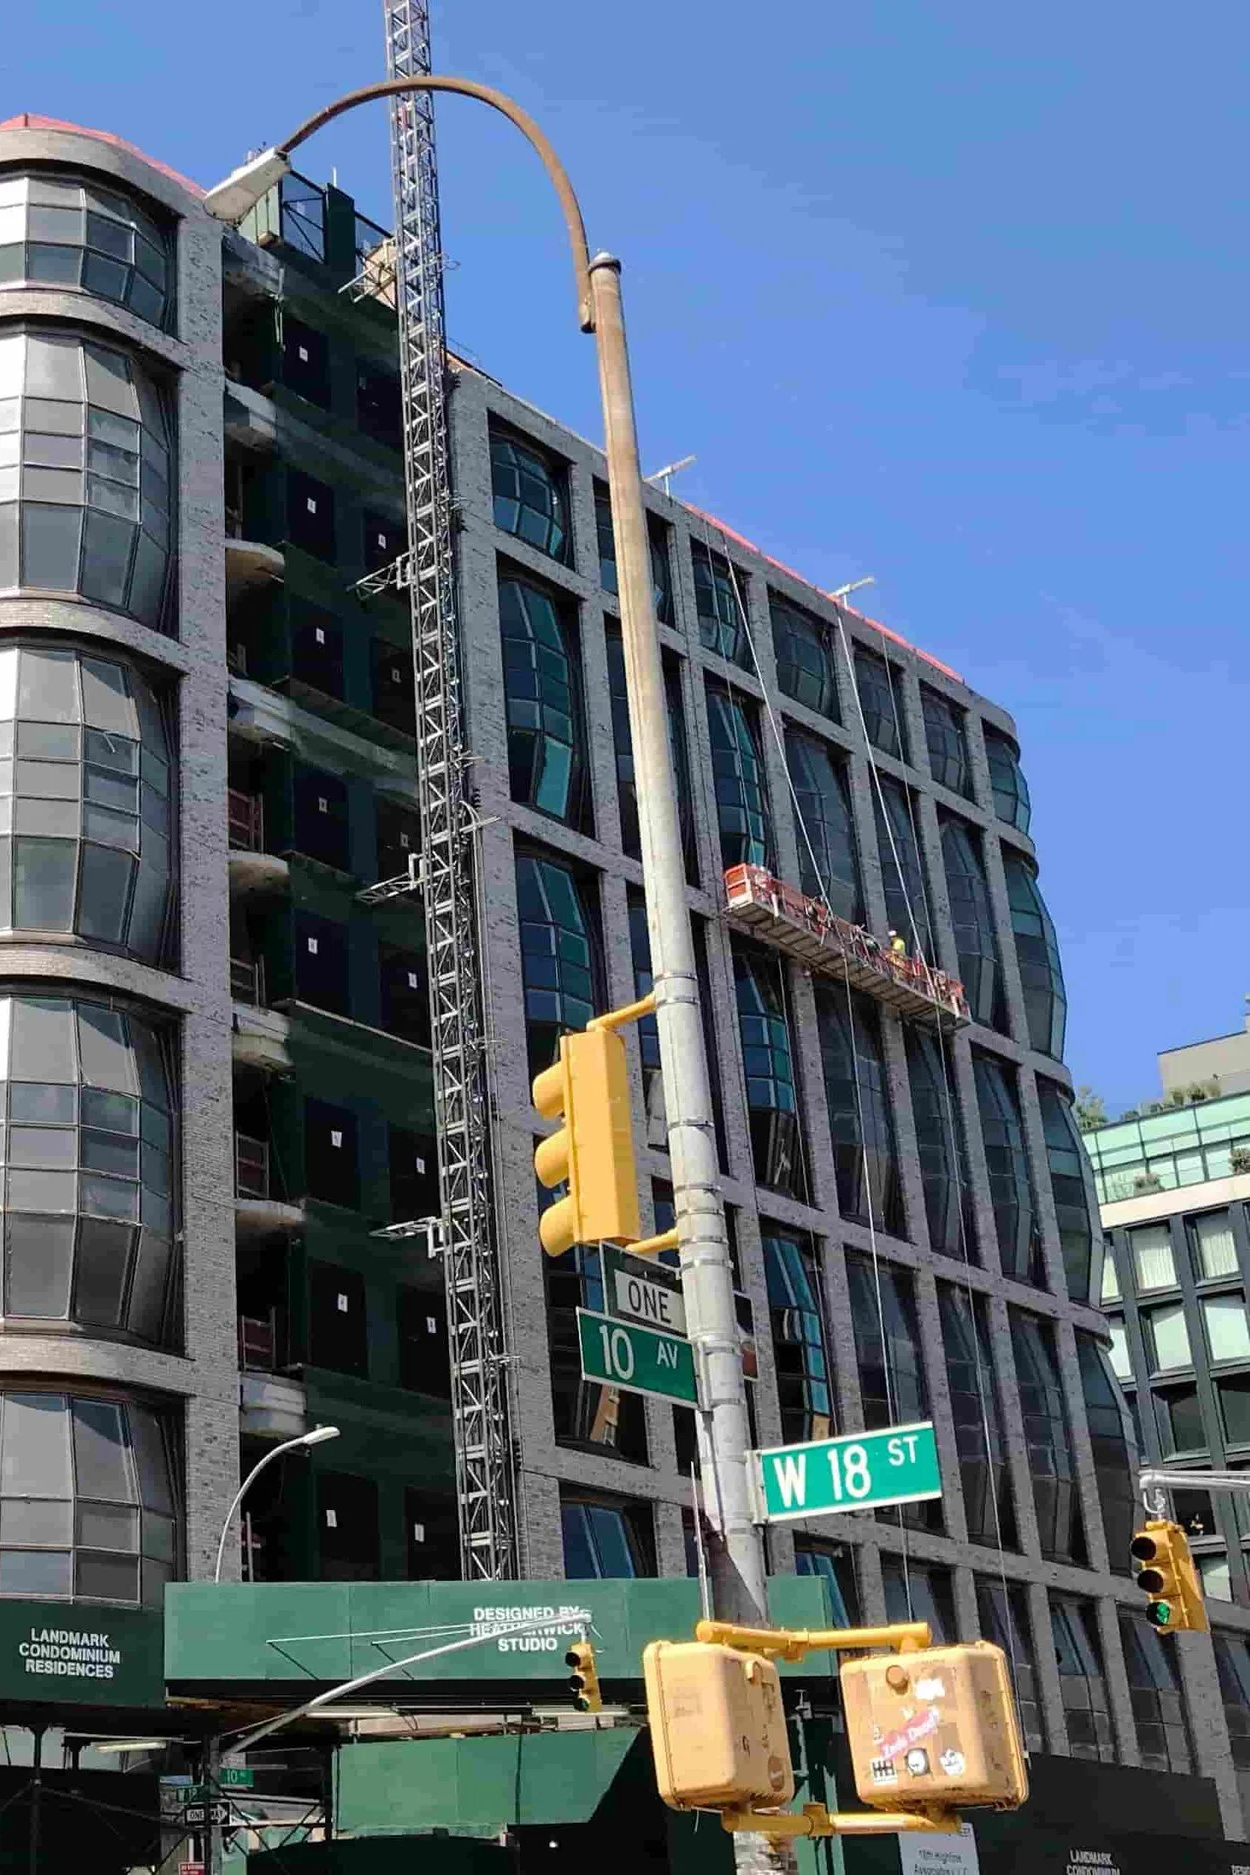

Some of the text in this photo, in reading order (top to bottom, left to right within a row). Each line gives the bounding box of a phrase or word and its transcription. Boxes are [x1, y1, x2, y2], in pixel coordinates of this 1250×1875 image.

[628, 1281, 671, 1323] ONE
[599, 1325, 678, 1380] 10 AV
[773, 1435, 918, 1508] W 18 ST
[474, 1606, 554, 1621] DESIGNED
[31, 1628, 110, 1648] LANDMARK
[498, 1638, 558, 1652] STUDIO
[19, 1642, 121, 1664] CONDOMINIUM
[25, 1658, 114, 1678] RESIDENCES
[190, 1810, 204, 1820] ONE
[1070, 1849, 1113, 1866] LANDMARK
